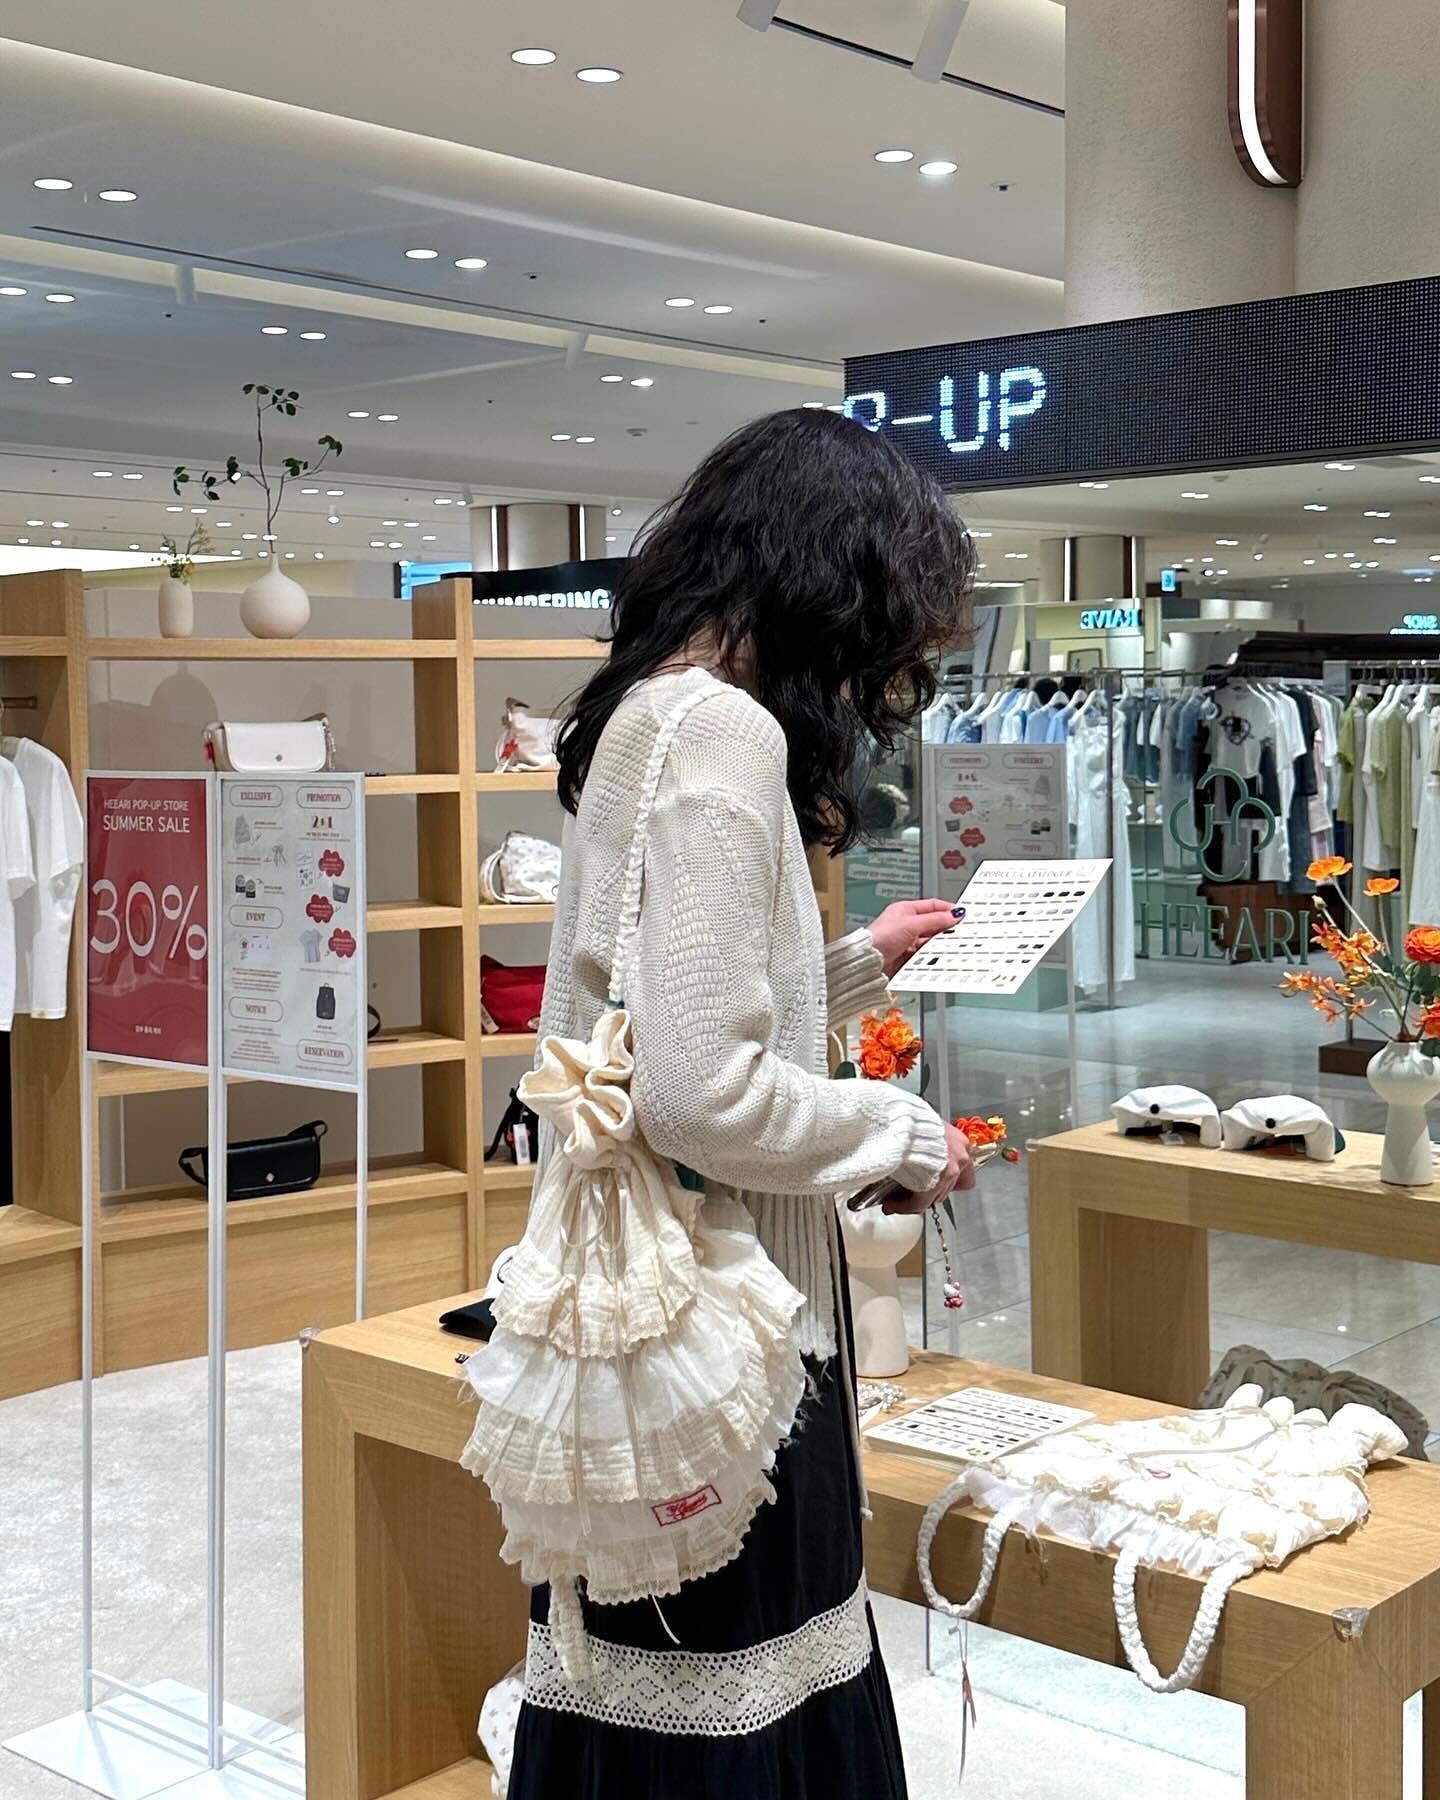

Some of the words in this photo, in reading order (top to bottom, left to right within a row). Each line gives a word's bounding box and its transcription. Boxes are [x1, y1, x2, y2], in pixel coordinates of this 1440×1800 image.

[104, 798, 131, 810] HEEARI
[132, 799, 162, 811] POP-UP
[163, 800, 190, 812] STORE
[103, 814, 154, 831] SUMMER
[158, 816, 190, 833] SALE
[90, 878, 208, 961] 30%
[246, 911, 266, 922] EVENT
[1136, 902, 1312, 966] HEEARI
[245, 1003, 267, 1014] NOTICE
[303, 1045, 345, 1059] RESERVATION
